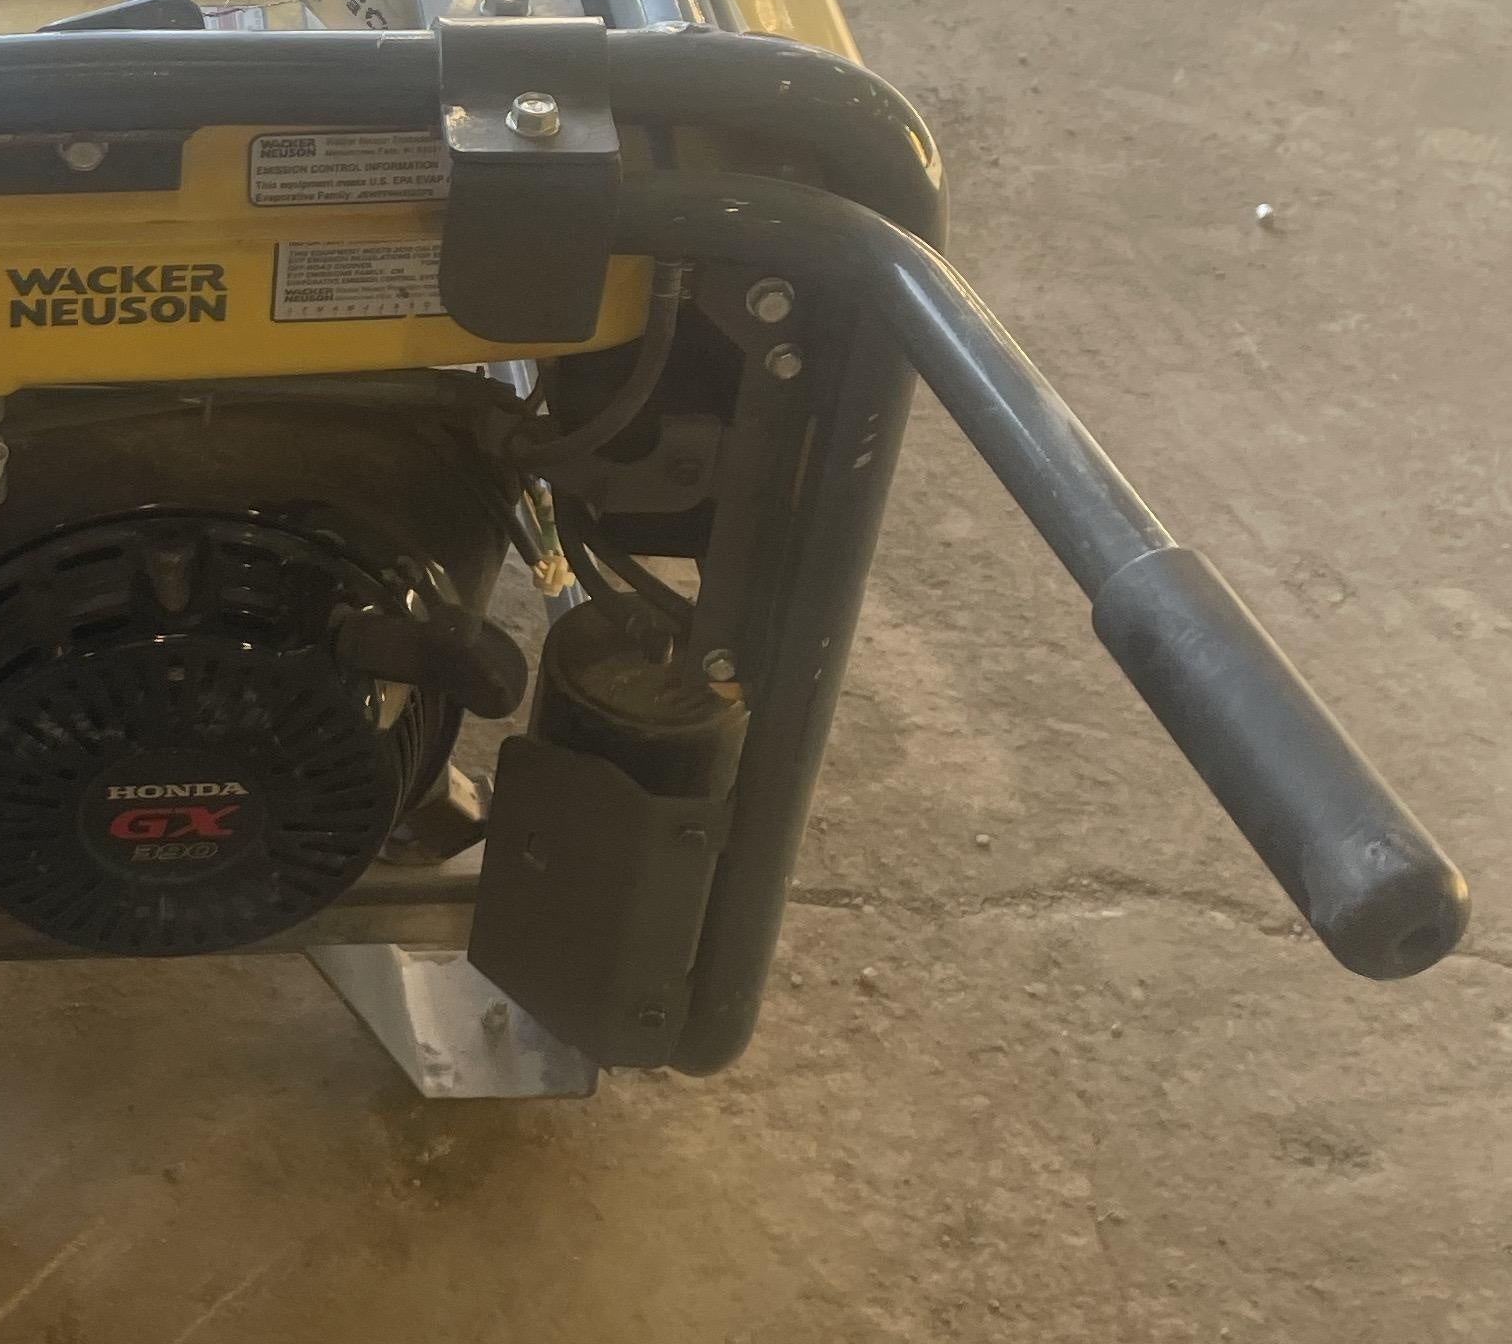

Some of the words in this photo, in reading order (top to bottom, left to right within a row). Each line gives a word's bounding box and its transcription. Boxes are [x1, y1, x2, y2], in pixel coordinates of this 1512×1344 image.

[259, 138, 316, 148] WACKER
[259, 147, 316, 158] NEUSON
[310, 163, 362, 174] CONTROL
[364, 160, 440, 172] INFORMATION
[392, 175, 414, 186] EPA
[415, 174, 444, 185] EVAP
[6, 263, 228, 297] WACKER
[9, 294, 228, 328] NEUSON
[107, 782, 250, 800] HONDA
[110, 804, 241, 839] GX
